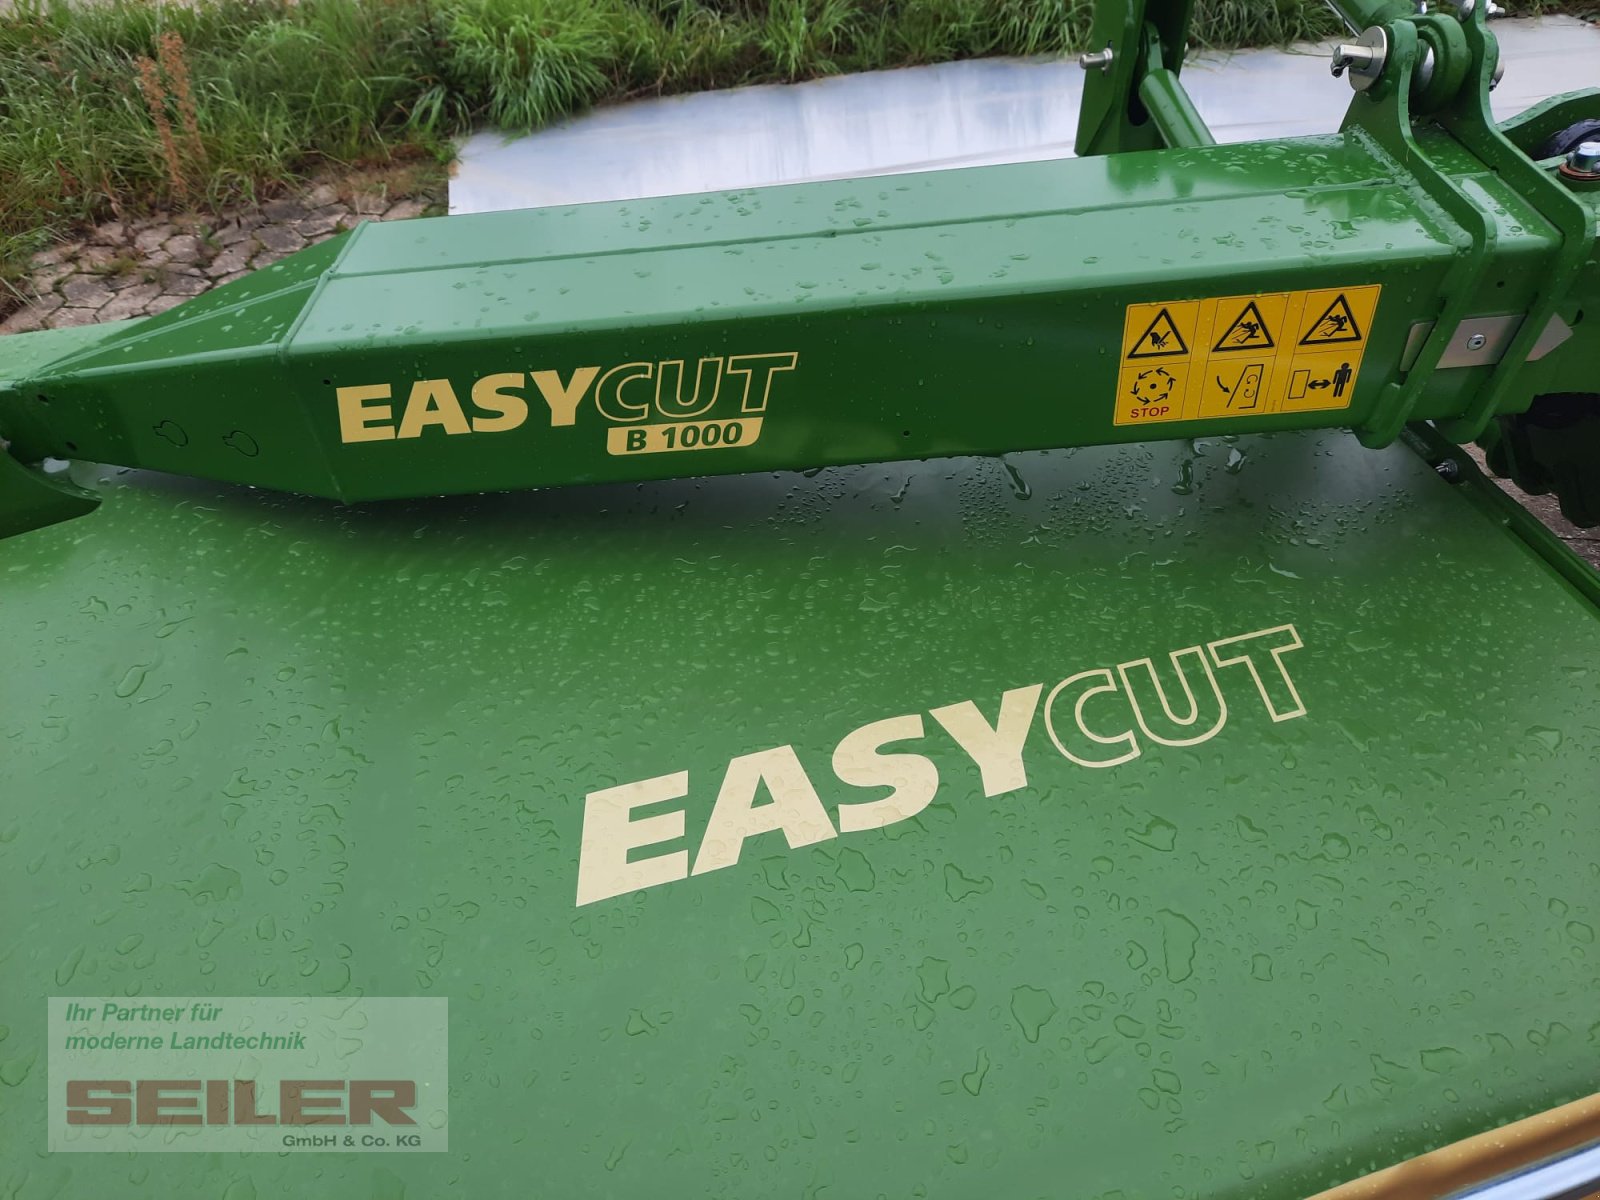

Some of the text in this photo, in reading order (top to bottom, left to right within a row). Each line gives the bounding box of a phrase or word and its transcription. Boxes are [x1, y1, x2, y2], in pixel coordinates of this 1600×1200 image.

[336, 352, 798, 443] EASYCUT
[1130, 407, 1169, 418] STOP
[626, 422, 743, 452] B 1000
[576, 623, 1307, 908] EASYCUT
